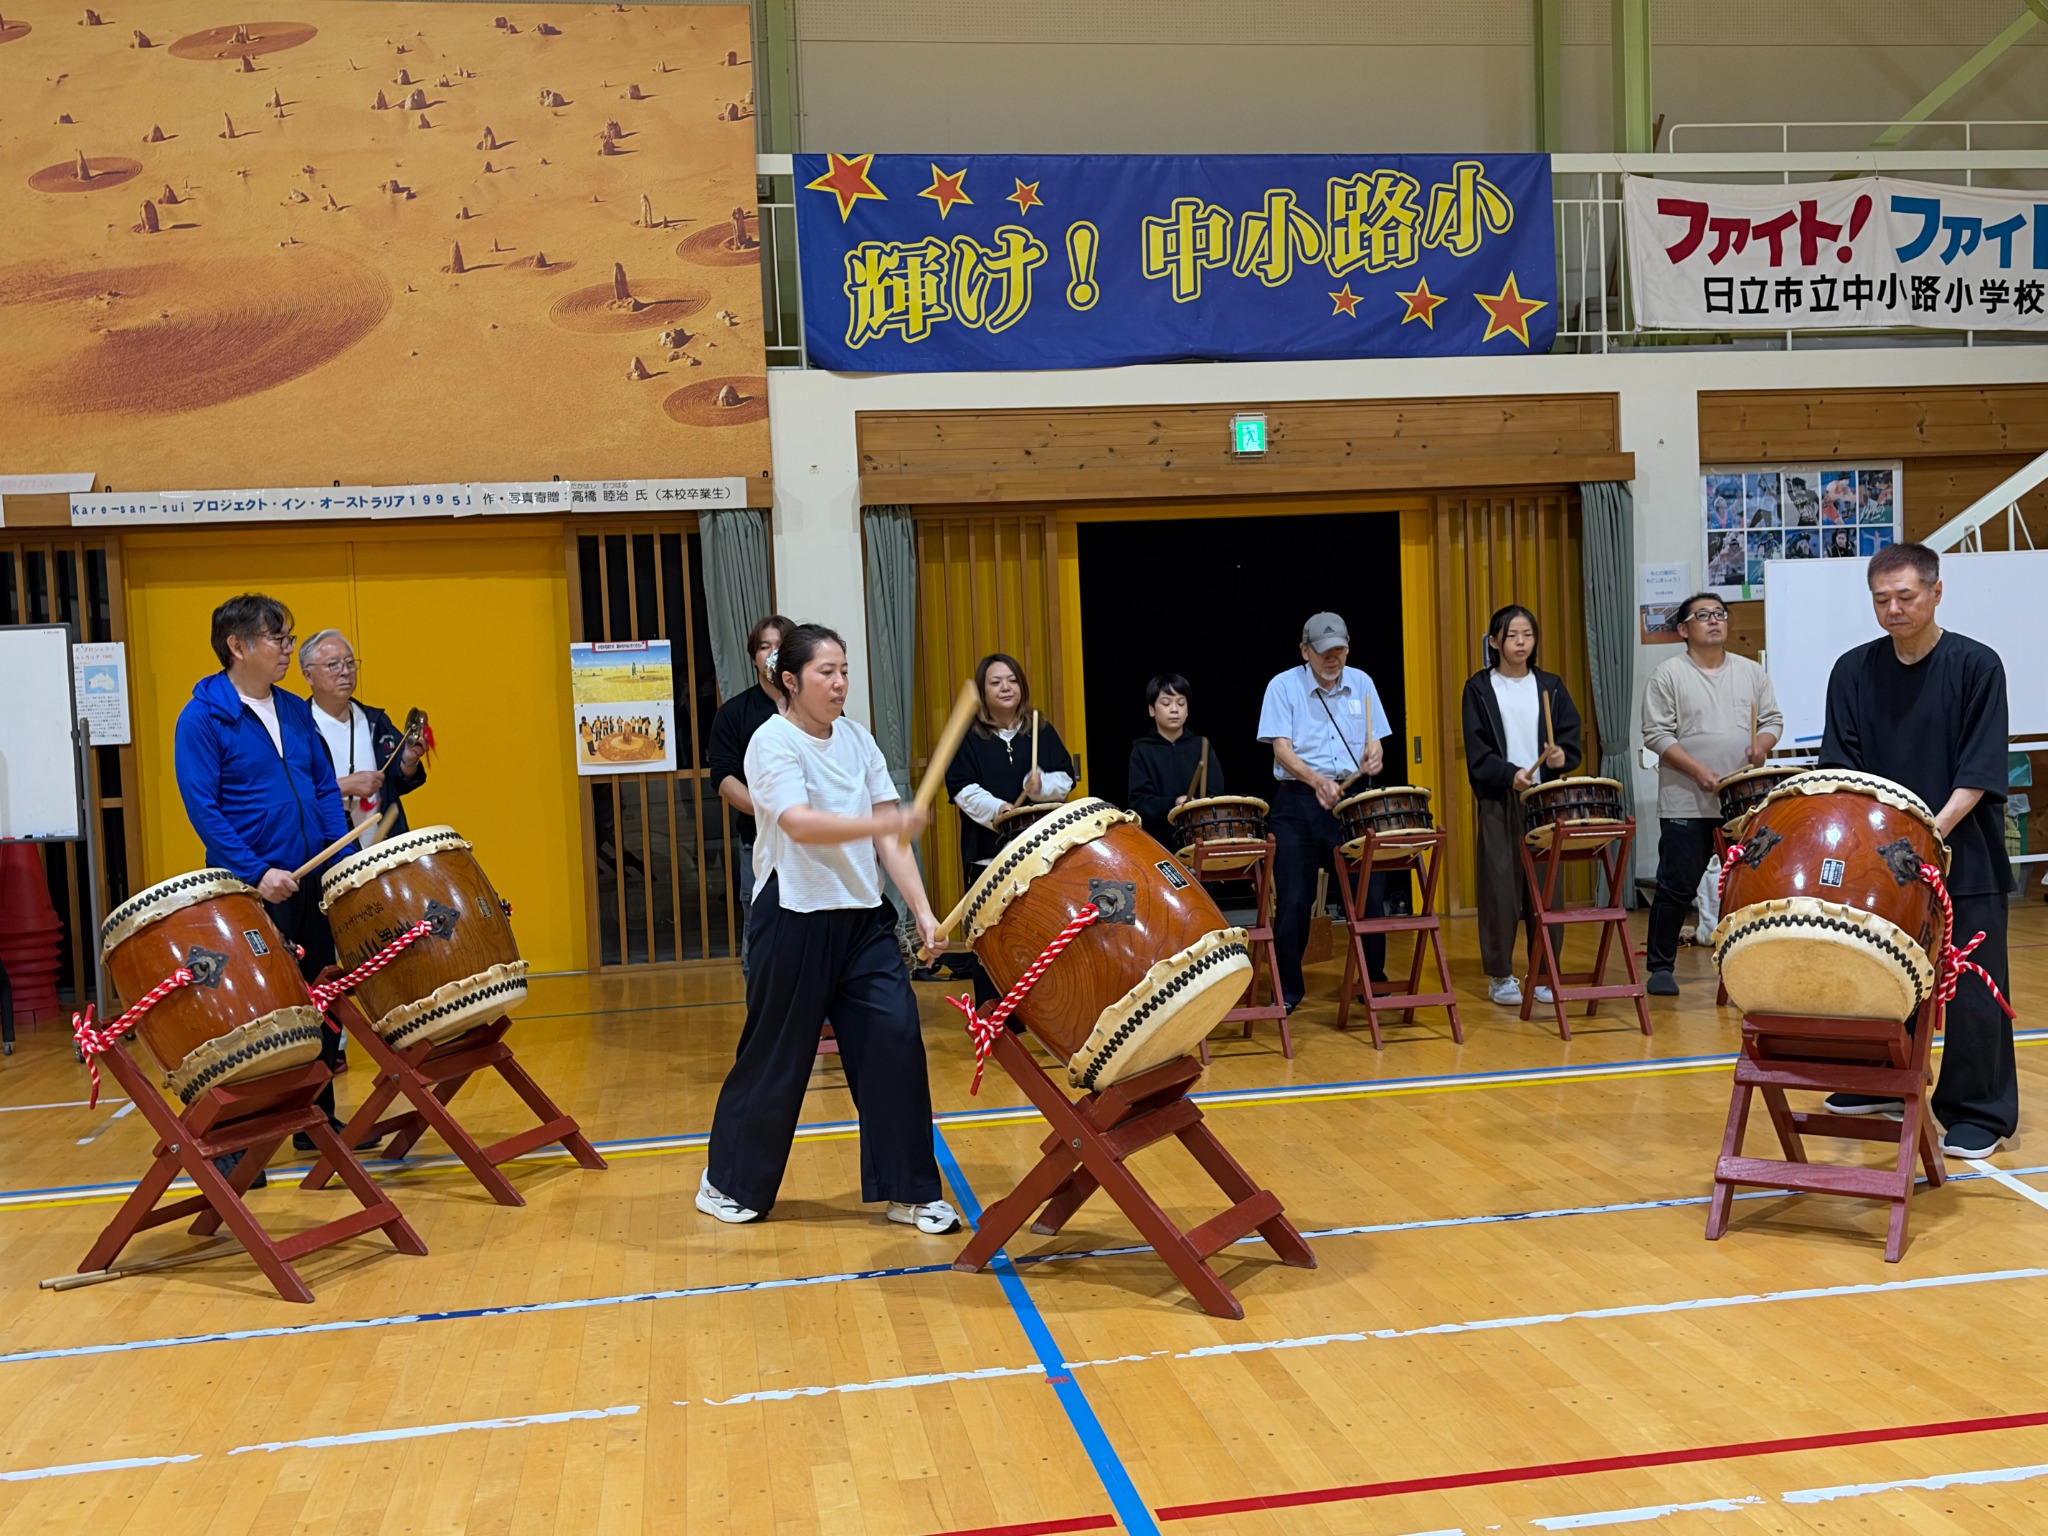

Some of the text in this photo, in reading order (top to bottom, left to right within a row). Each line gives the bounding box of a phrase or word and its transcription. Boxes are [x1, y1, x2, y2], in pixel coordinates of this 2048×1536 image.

[844, 160, 1514, 349] 輝け! 中小路小
[1657, 194, 1873, 267] ファイト!
[1703, 272, 2045, 315] 日立市立中小路小学校
[603, 488, 629, 502] 睦治
